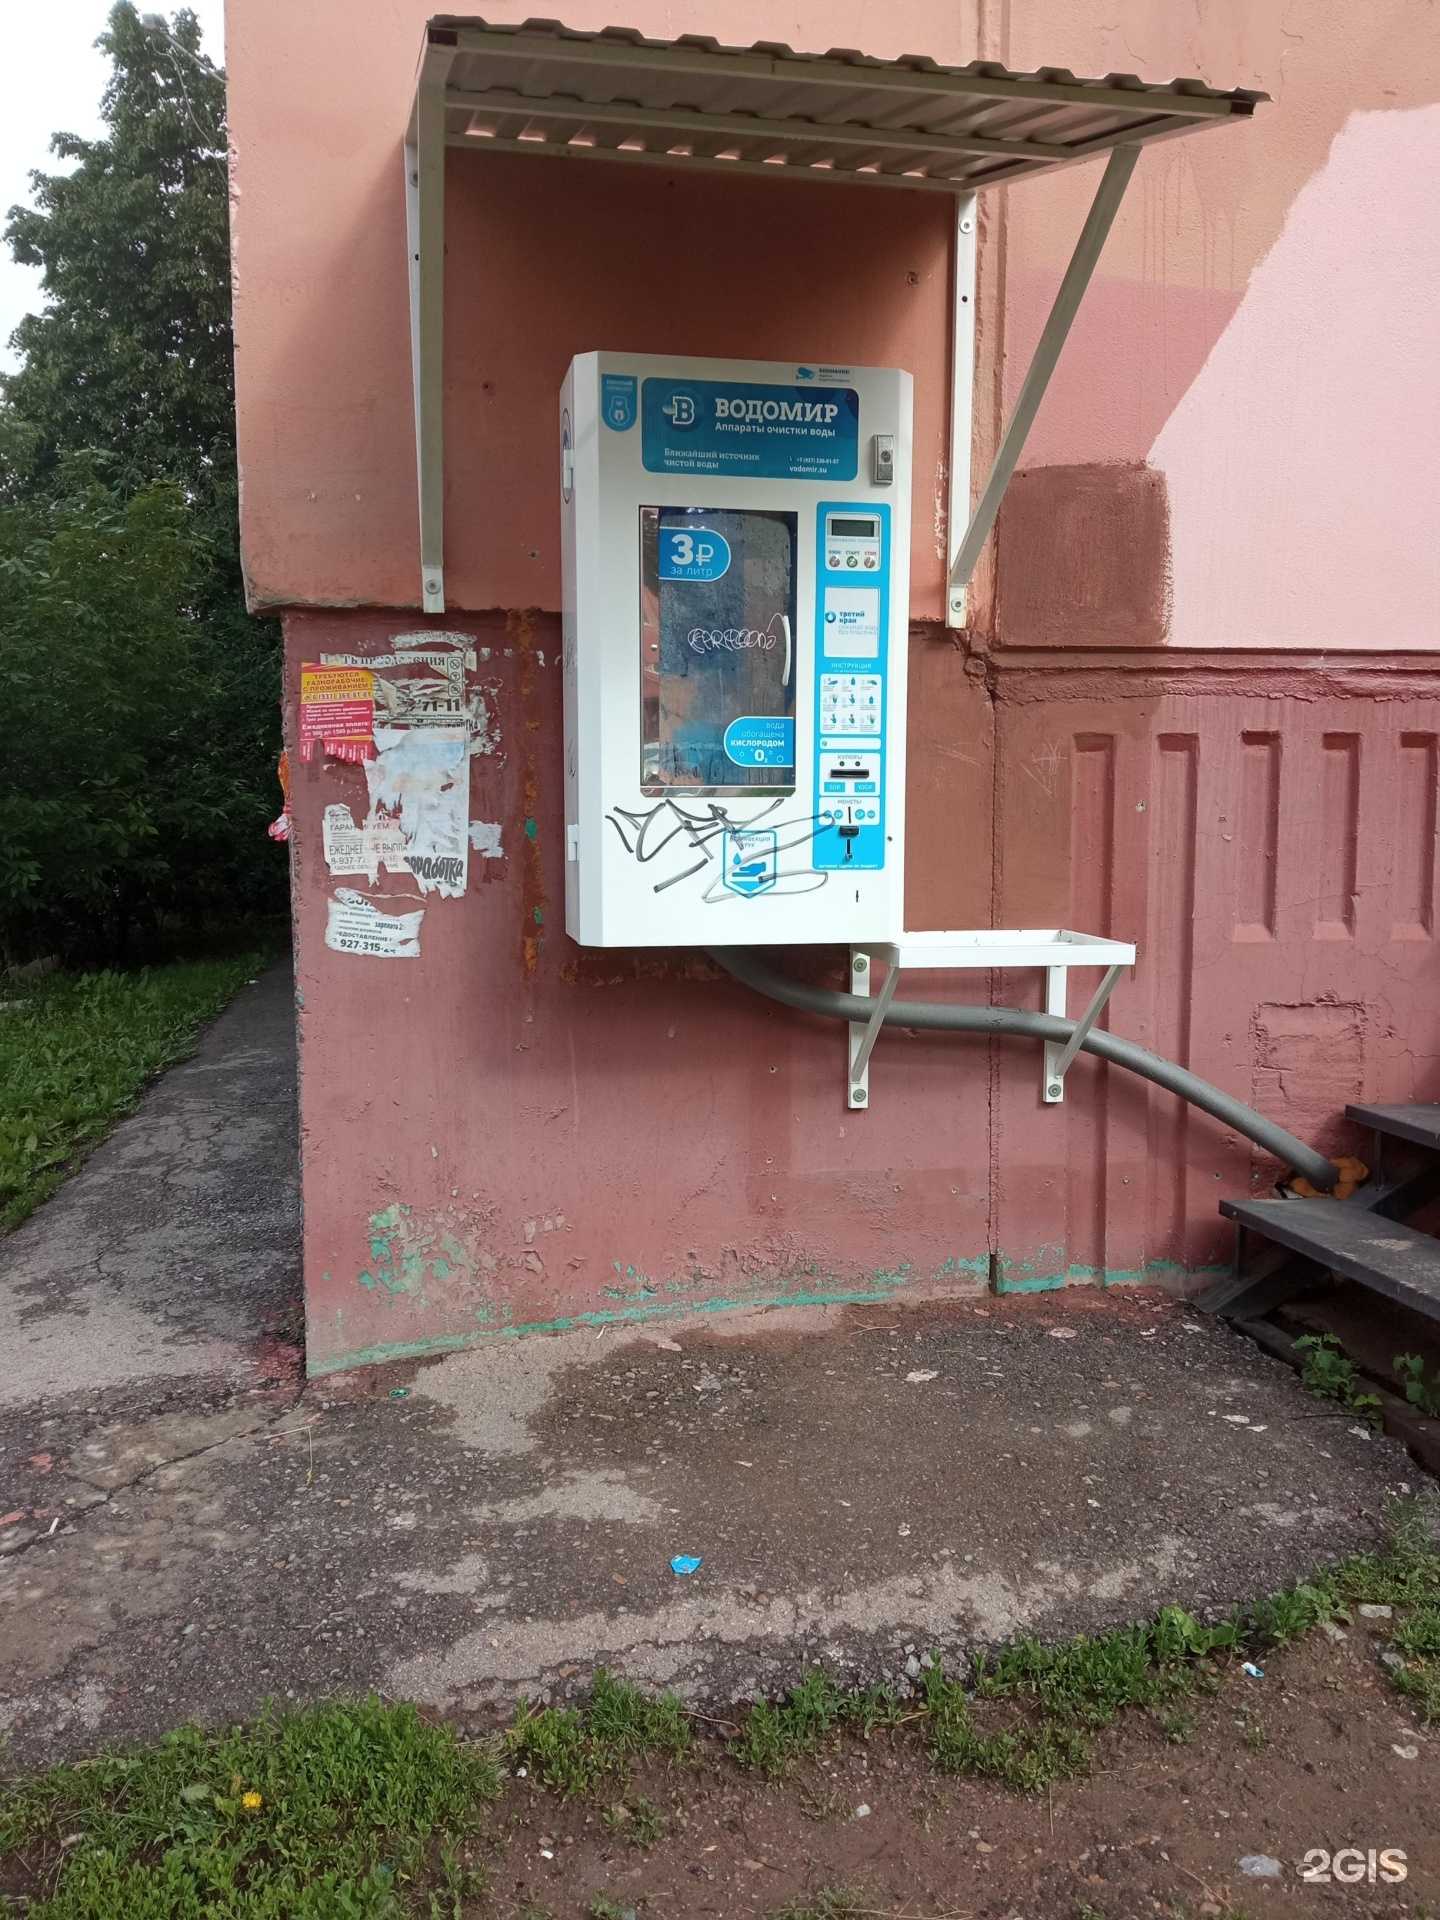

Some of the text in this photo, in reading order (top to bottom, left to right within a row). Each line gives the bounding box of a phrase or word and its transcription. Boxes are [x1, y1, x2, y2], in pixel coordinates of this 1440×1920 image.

[715, 398, 838, 423] ВОДОМИР
[715, 422, 836, 437] Аппараты очистки воды
[664, 448, 760, 460] Ближайший источник
[664, 459, 695, 467] чистой
[789, 465, 828, 473] vodomir.su
[687, 568, 713, 578] литр
